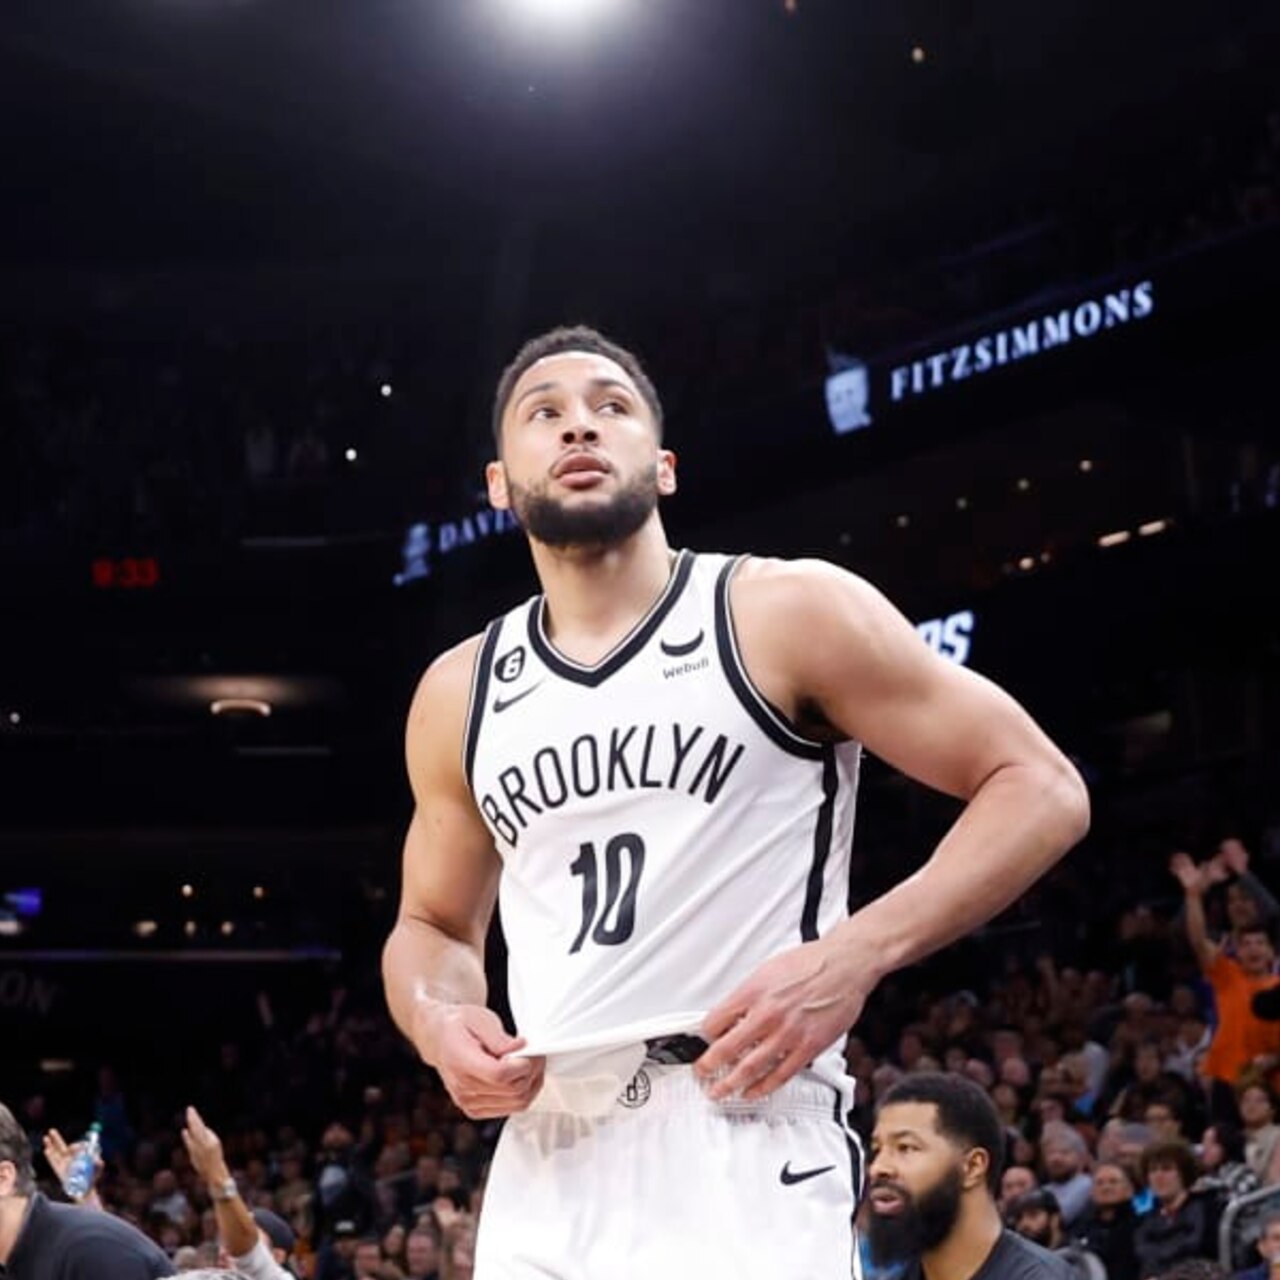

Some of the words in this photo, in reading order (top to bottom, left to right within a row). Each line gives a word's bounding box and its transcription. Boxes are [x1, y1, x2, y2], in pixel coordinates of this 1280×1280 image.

[891, 281, 1154, 400] FITZSIMMONS
[481, 723, 746, 848] BROOKLYN
[568, 832, 646, 955] 10
